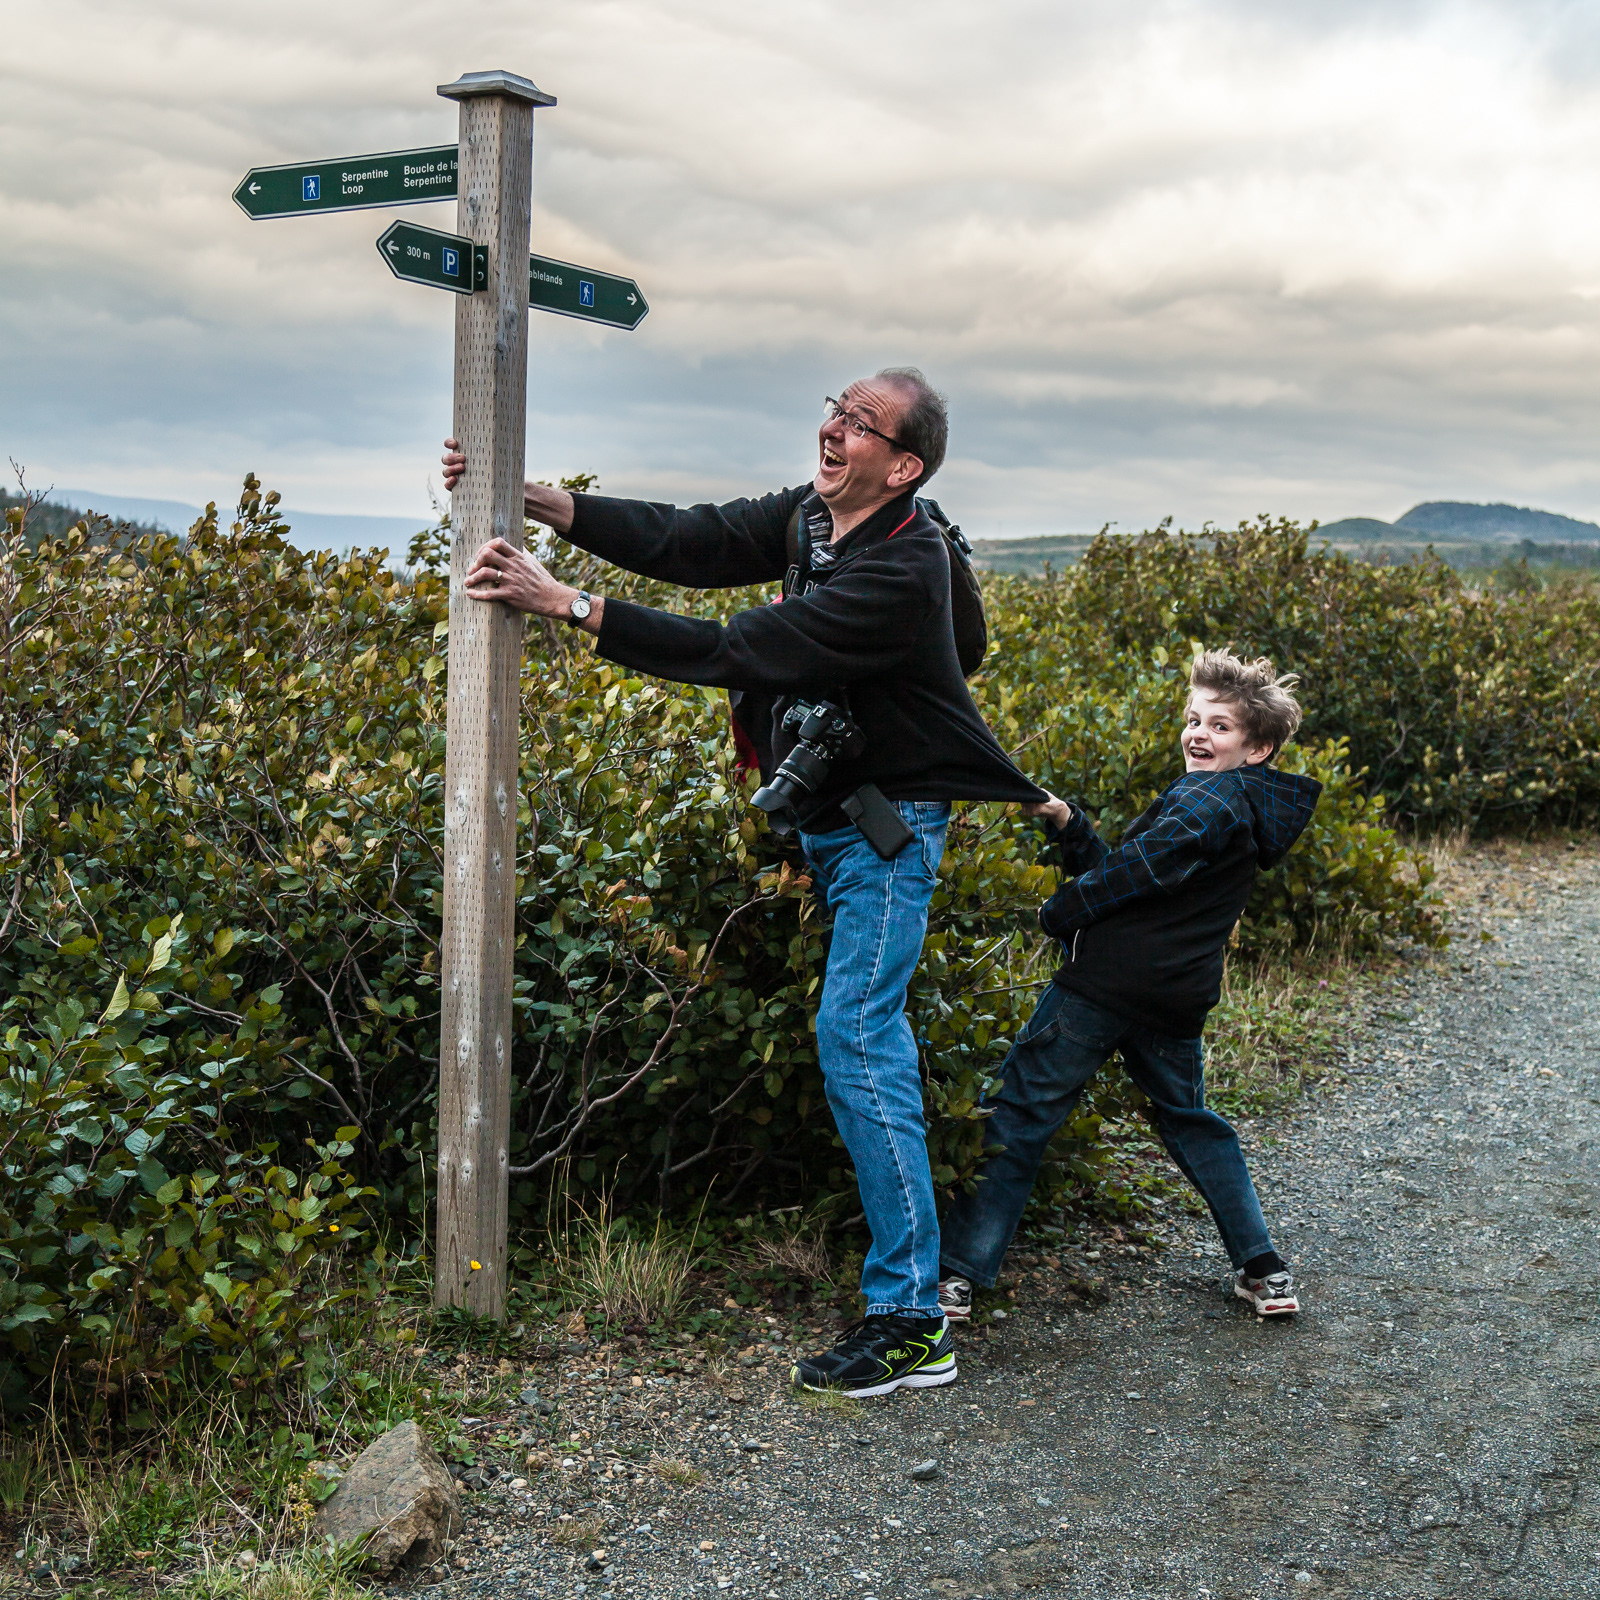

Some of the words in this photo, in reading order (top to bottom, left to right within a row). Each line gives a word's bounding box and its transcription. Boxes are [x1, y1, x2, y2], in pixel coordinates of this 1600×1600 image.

[404, 163, 434, 174] Boucle
[437, 161, 448, 171] de
[450, 160, 458, 170] la
[342, 169, 388, 182] Serpentine
[404, 174, 452, 187] Serpentine
[342, 184, 363, 194] Loop
[407, 246, 421, 258] 300
[423, 251, 430, 260] m
[446, 252, 455, 270] P
[528, 269, 563, 285] ablelands
